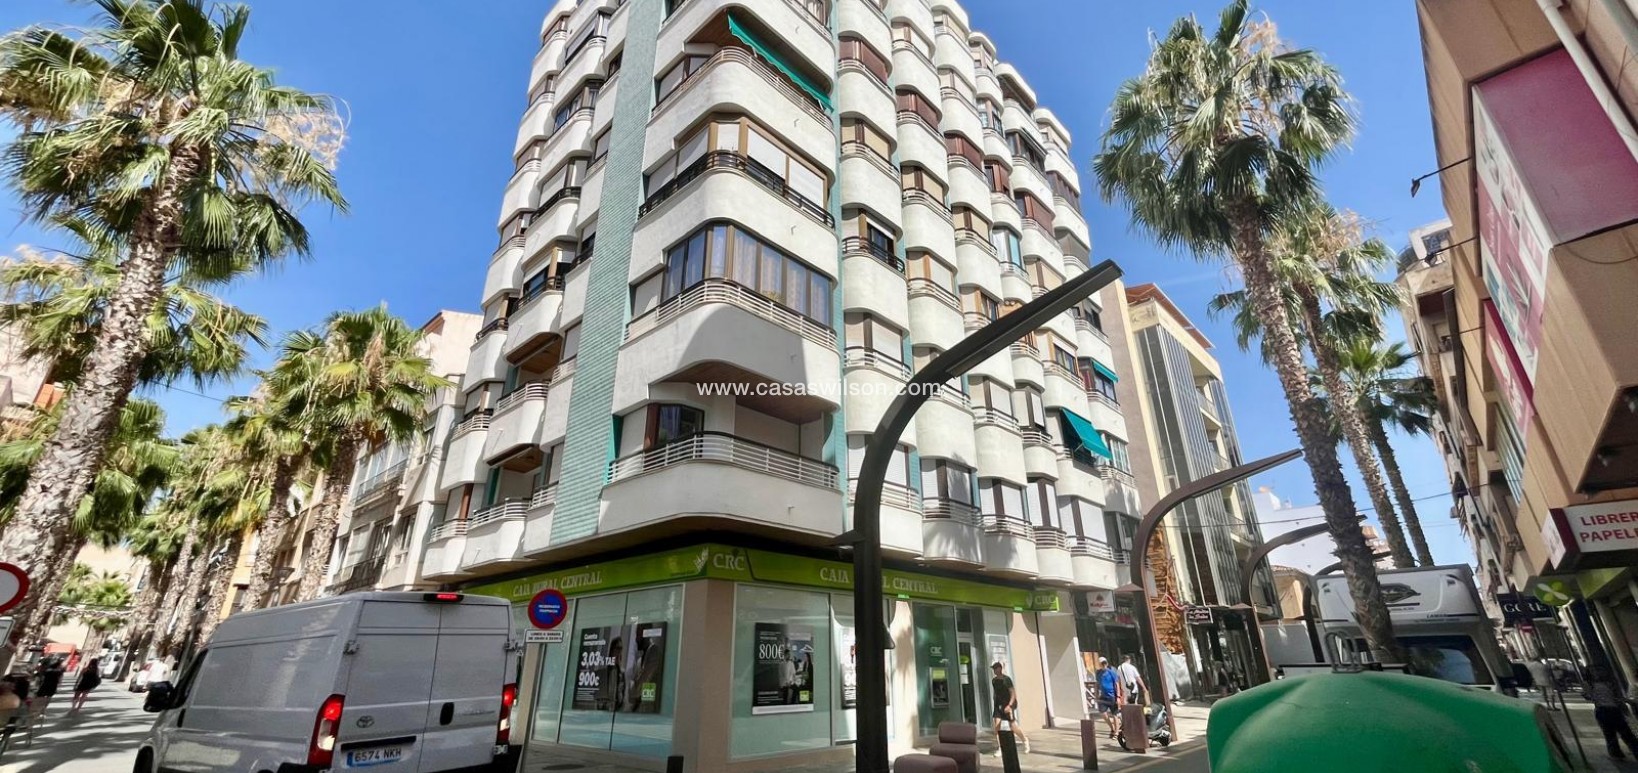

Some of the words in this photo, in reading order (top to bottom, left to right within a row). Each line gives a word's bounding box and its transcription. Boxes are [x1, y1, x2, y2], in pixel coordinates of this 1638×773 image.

[713, 553, 745, 571] CRC
[561, 571, 603, 589] CENTRAL
[819, 567, 849, 583] CAJA
[893, 577, 938, 594] CENTRAL
[759, 643, 785, 659] 800€
[605, 656, 616, 666] TAE
[355, 750, 380, 762] 6574
